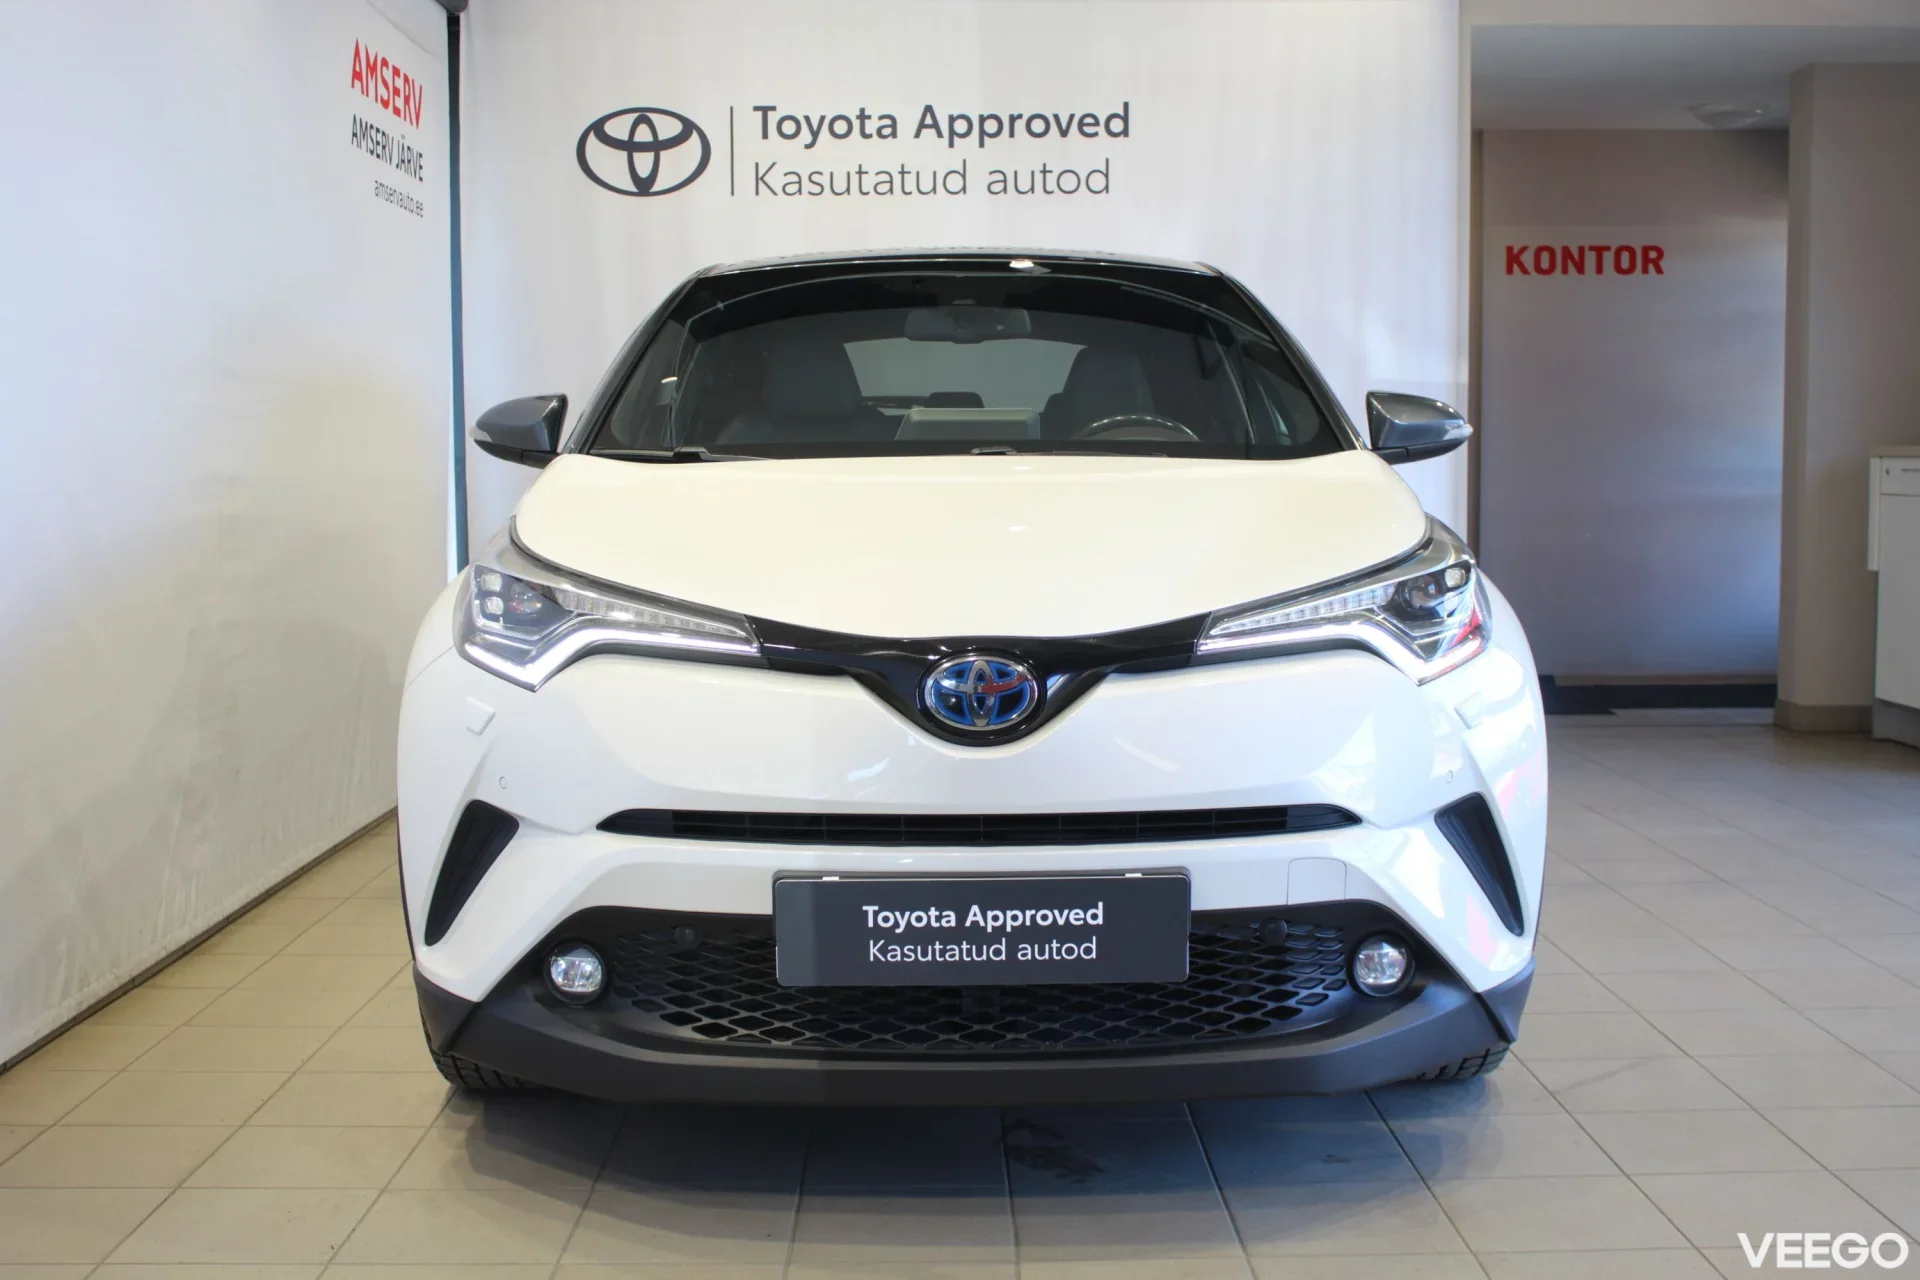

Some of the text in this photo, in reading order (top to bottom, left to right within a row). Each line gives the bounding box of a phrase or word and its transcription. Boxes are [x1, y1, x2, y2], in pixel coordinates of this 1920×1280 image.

[351, 36, 423, 130] AMSERV
[753, 101, 1130, 150] Toyota Approved
[351, 113, 424, 183] AMSERV JÄRVE
[754, 158, 1110, 197] Kasutatud autod
[374, 179, 424, 218] amservauto.ee
[1505, 244, 1665, 276] KONTOR
[862, 902, 1104, 933] Toyota Approved
[868, 936, 1097, 962] Kasutatud autod
